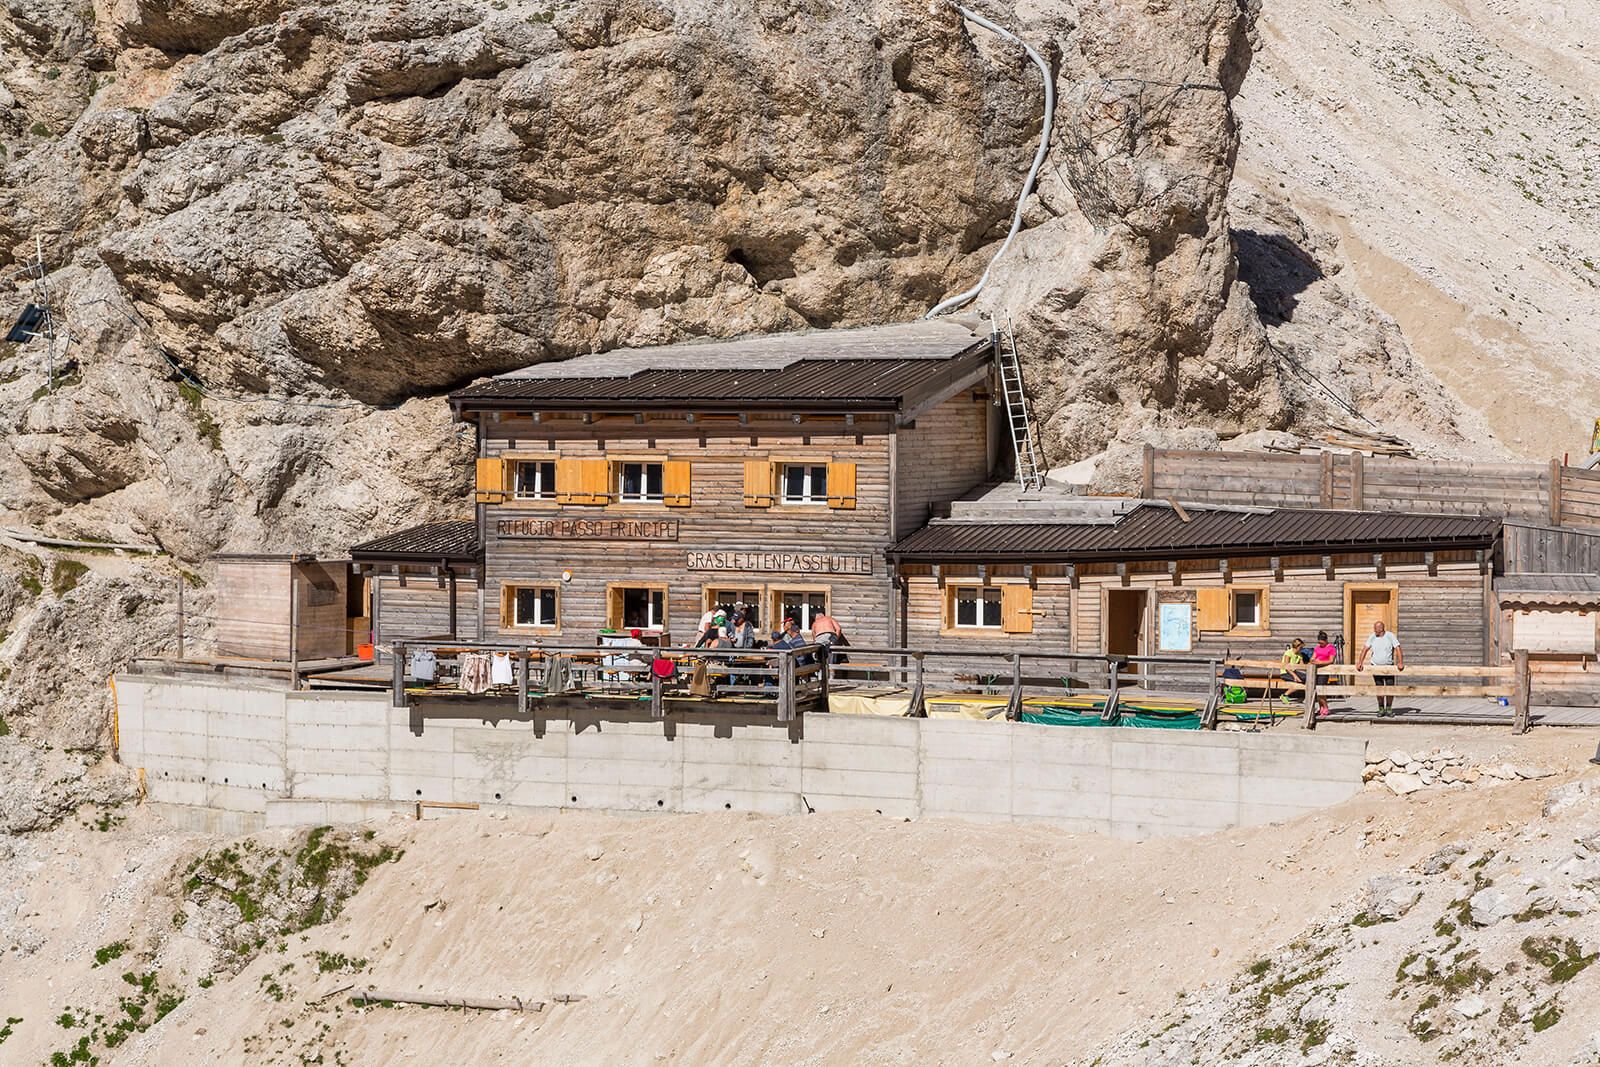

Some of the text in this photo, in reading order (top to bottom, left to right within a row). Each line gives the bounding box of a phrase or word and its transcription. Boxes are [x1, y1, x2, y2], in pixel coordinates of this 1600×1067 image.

[497, 519, 676, 537] RIFUGIO PASSO PRINCIPE
